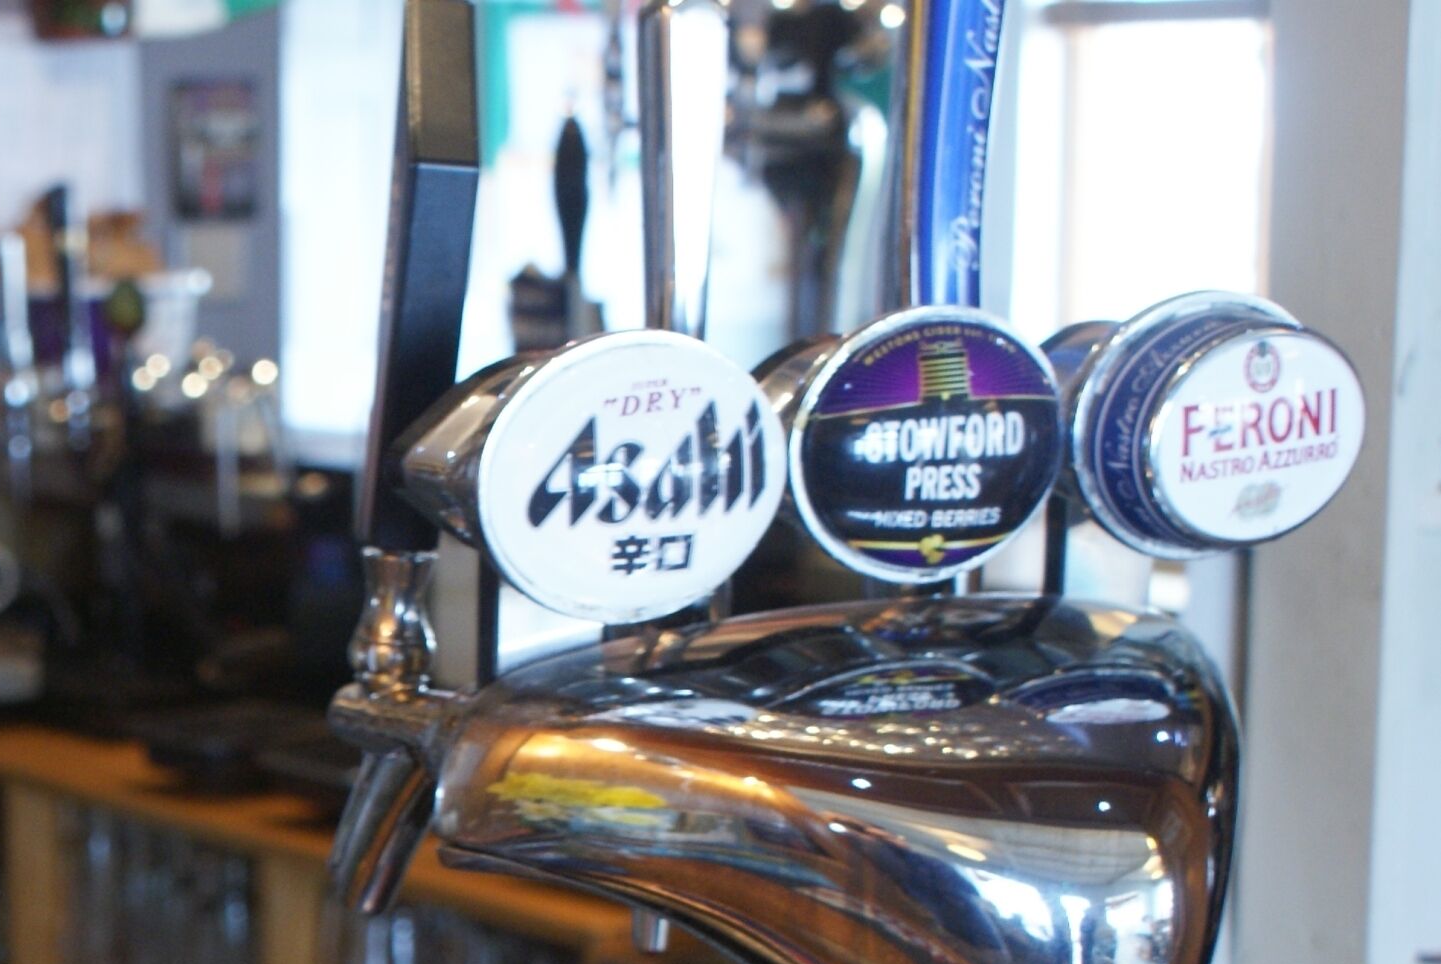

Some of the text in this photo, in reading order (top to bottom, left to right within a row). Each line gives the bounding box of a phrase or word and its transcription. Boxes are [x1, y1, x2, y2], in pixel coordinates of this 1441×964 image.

[864, 411, 1026, 463] STOWFORD
[527, 398, 766, 528] Asahi
[904, 464, 982, 501] PRESS
[1179, 441, 1339, 483] NASTRO AZZURRO
[932, 507, 1002, 529] BERRIES
[610, 533, 694, 576] 辛口
